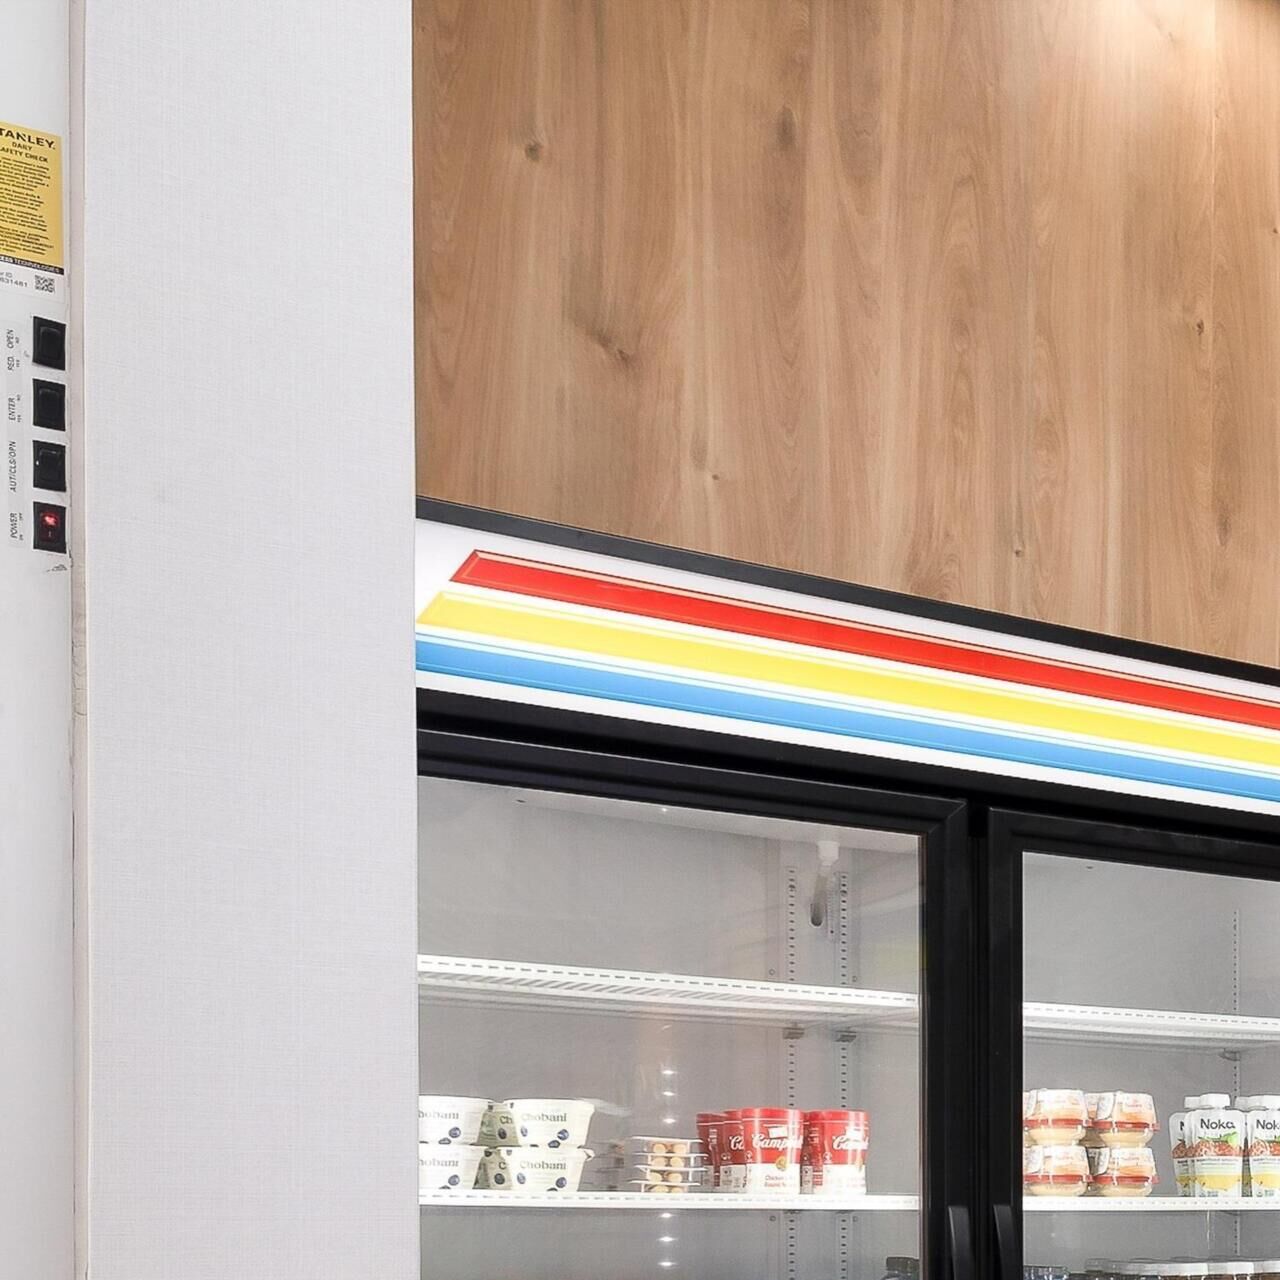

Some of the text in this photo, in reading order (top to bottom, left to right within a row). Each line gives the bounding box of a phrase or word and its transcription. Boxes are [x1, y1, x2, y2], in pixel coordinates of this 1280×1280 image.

[12, 141, 33, 151] DAILY
[25, 152, 48, 163] CHECK
[10, 512, 18, 539] POWER
[521, 1113, 567, 1122] Chobani
[1200, 1119, 1236, 1131] Noka
